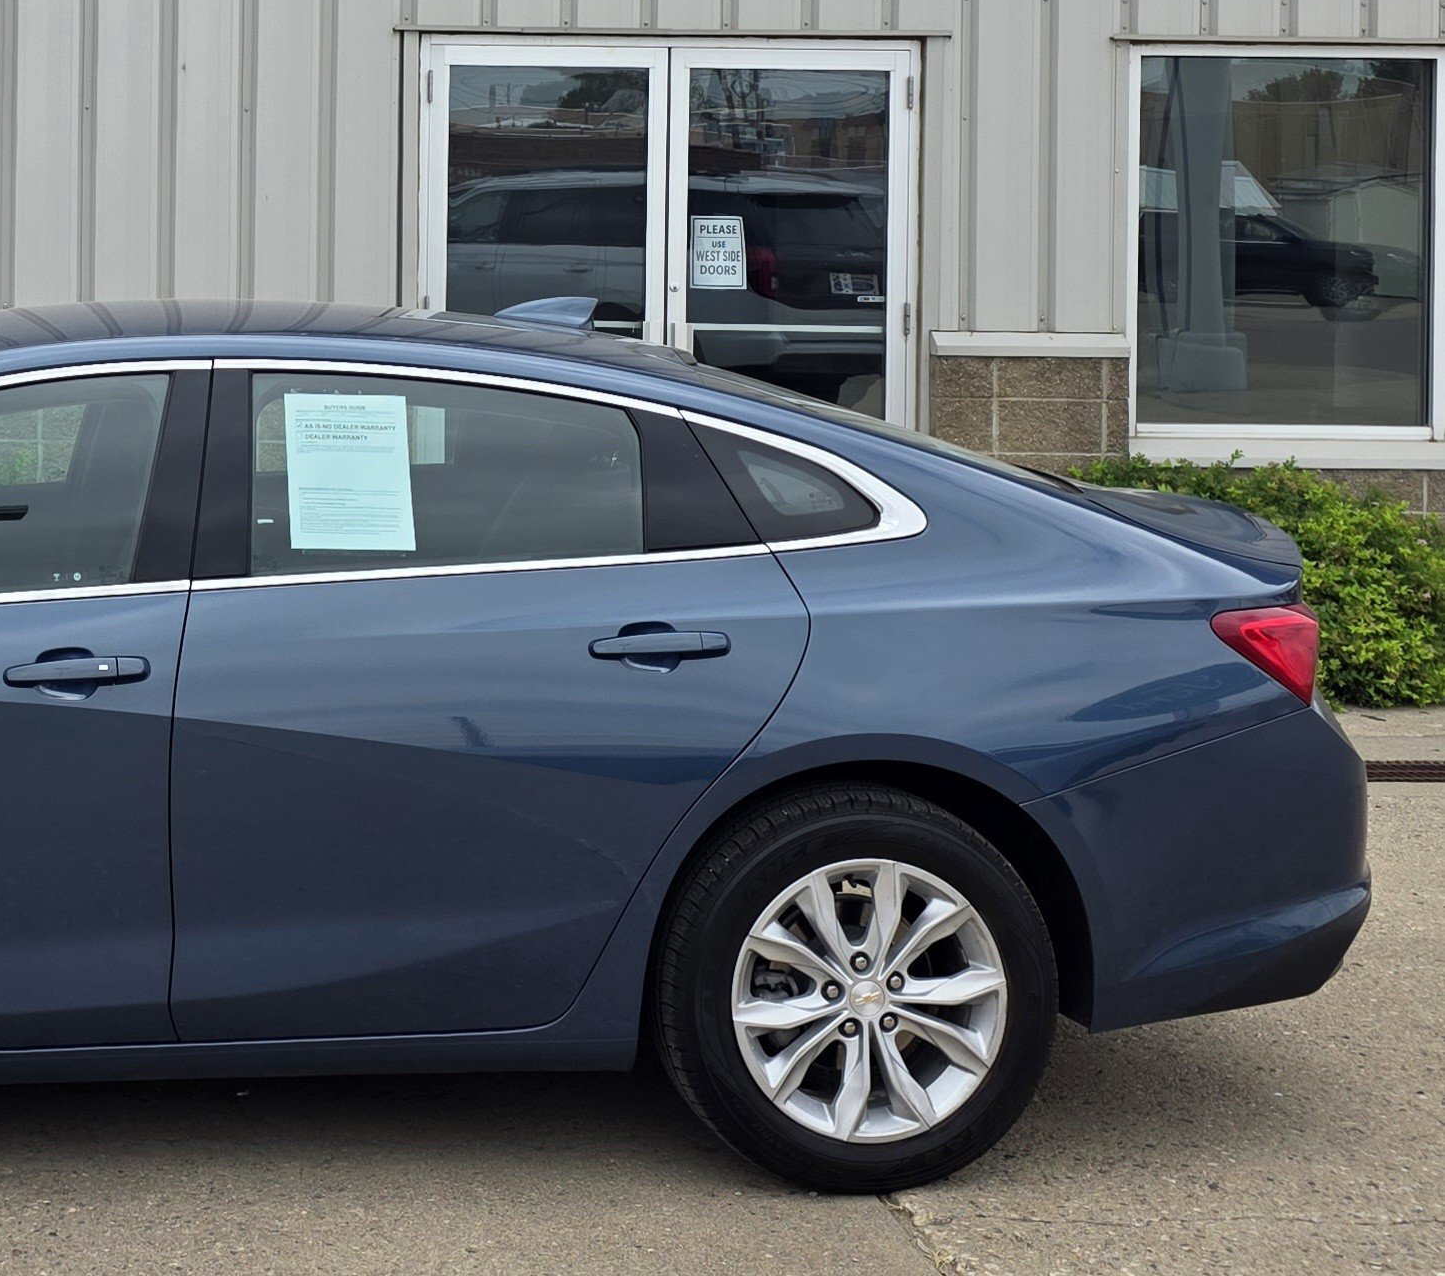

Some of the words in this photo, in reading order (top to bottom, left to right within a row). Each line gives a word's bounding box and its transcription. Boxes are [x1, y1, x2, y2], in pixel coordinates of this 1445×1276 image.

[699, 224, 737, 235] PLEASE
[711, 240, 726, 248] USE
[696, 250, 720, 262] WEST
[723, 250, 741, 262] SIDE
[700, 264, 737, 276] DOORS
